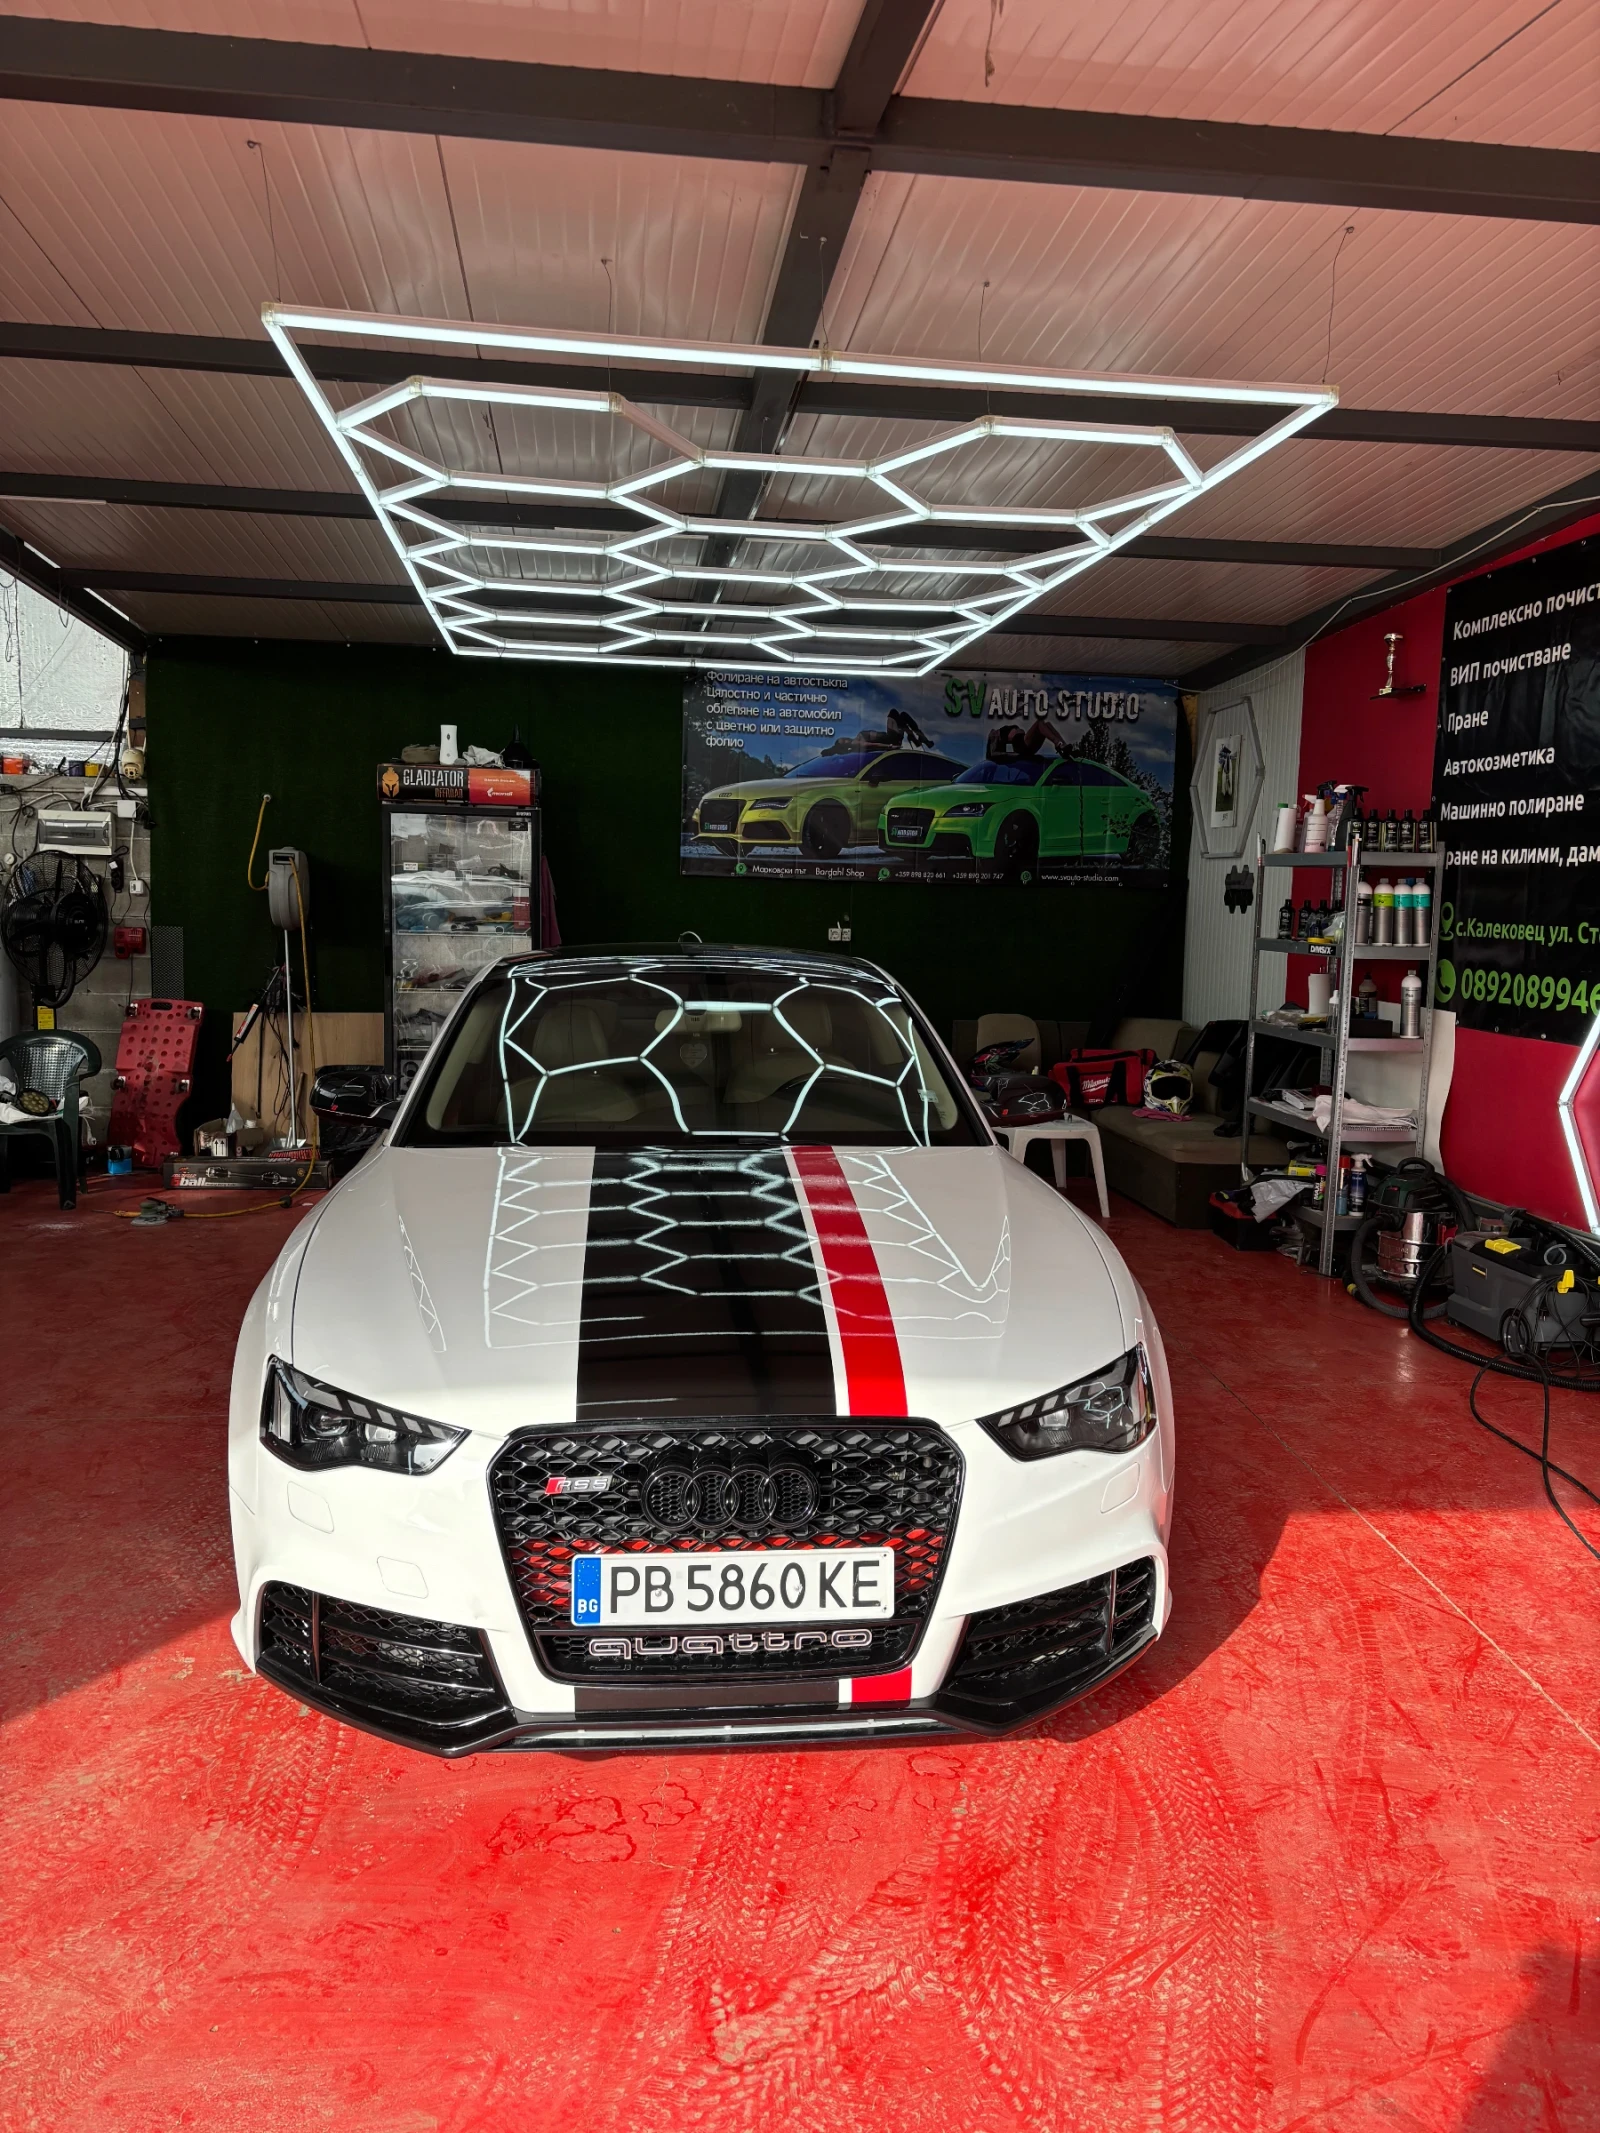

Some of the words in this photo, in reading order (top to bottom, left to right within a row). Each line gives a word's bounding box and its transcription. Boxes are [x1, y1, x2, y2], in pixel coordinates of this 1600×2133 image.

[1453, 600, 1543, 641] Комплексно
[1450, 661, 1480, 687] ВИП
[1483, 642, 1572, 679] почистване
[706, 670, 764, 684] Фолиране
[766, 675, 781, 685] на
[783, 675, 848, 689] автостъкла
[706, 687, 760, 700] Цялостно
[763, 692, 771, 700] и
[774, 692, 827, 703] частично
[944, 678, 987, 717] SV
[988, 688, 1049, 718] AUTO
[1056, 689, 1140, 720] STUDIO
[706, 704, 760, 717] облепяне
[763, 708, 776, 717] на
[779, 709, 842, 720] автомобил
[1447, 710, 1489, 735] Пране
[706, 721, 713, 730] с
[716, 721, 757, 733] цветно
[760, 724, 781, 733] или
[784, 725, 835, 736] защитно
[705, 736, 744, 748] фолио
[1443, 746, 1555, 776] Автокозметика
[403, 768, 464, 787] GLADIATOR
[1440, 801, 1506, 821] Машинно
[1508, 793, 1585, 818] полиране
[1445, 849, 1479, 870] ране
[1481, 849, 1498, 866] на
[1501, 846, 1564, 867] килими,
[1566, 845, 1600, 867] дам
[846, 868, 865, 879] Shop
[1041, 872, 1119, 881] www.svauto-studio.com
[1455, 917, 1545, 946] с.Калековец
[1548, 925, 1573, 947] ул.
[1578, 921, 1600, 945] Ст
[610, 1564, 674, 1614] PB
[687, 1562, 806, 1612] 5860
[819, 1560, 881, 1609] KE
[577, 1598, 599, 1613] BG
[588, 1628, 873, 1660] quattro
